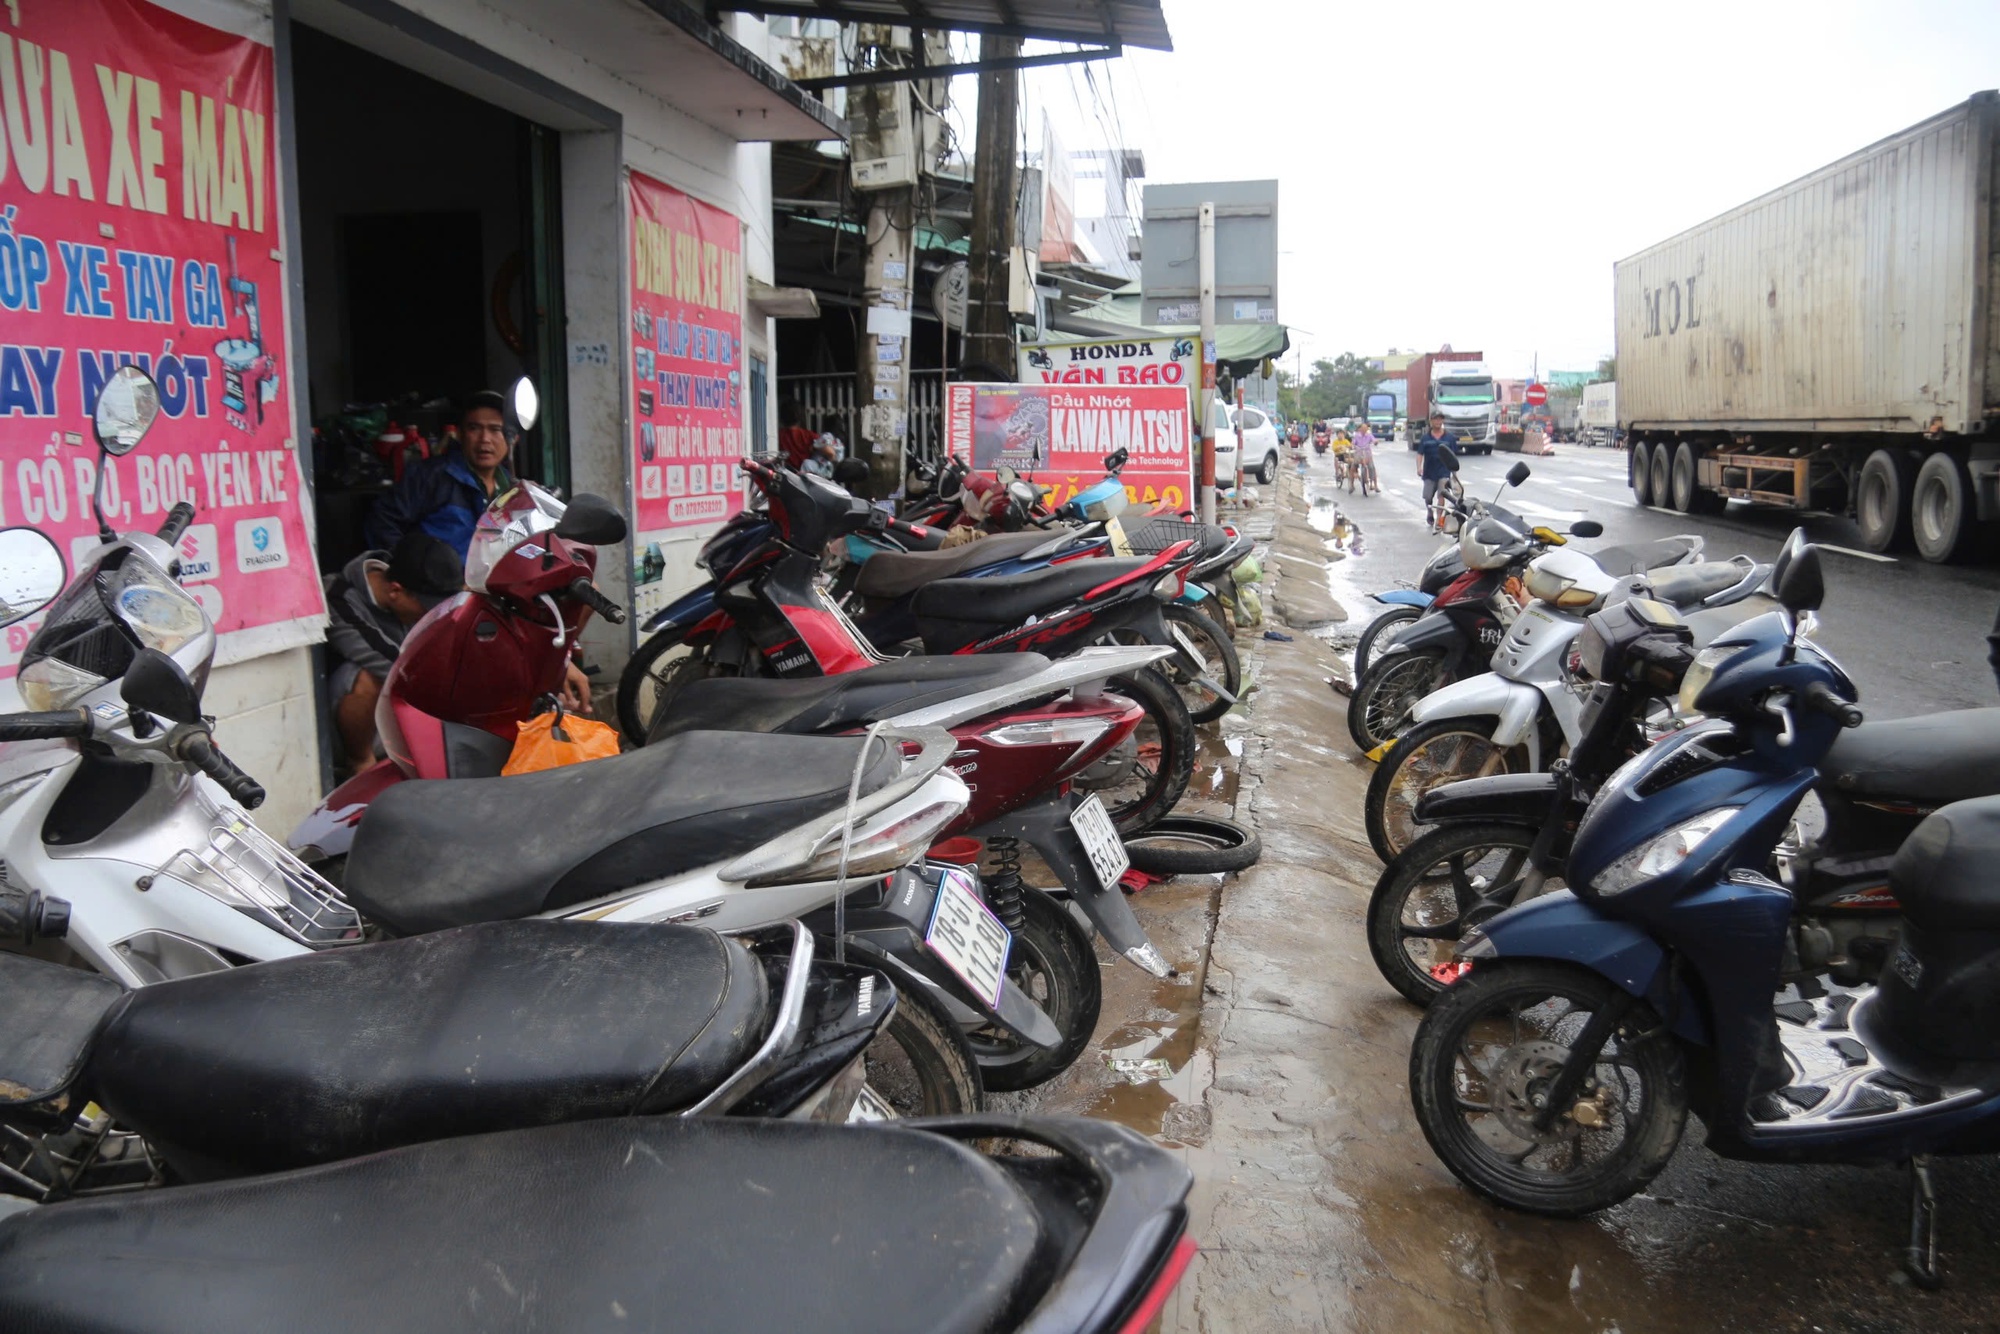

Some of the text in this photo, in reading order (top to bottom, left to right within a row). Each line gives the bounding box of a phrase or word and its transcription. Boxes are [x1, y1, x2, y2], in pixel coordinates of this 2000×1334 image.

[95, 63, 168, 215] XE
[180, 76, 265, 234] MÁY
[57, 240, 114, 318] XE
[116, 249, 175, 324] TAY
[183, 260, 227, 329] GA
[1643, 276, 1700, 339] MOL
[1070, 342, 1154, 361] HONDA
[77, 340, 209, 419] NỚT
[657, 370, 692, 409] THAY
[1051, 391, 1132, 408] Dầu Nhớt
[656, 425, 677, 458] THAY
[953, 386, 972, 467] AWAMATSU
[1051, 408, 1183, 453] KAWAMATSU
[17, 432, 68, 524] CỔ
[201, 440, 254, 509] YÊN
[256, 450, 288, 503] XE
[1139, 455, 1184, 467] Technology
[178, 560, 211, 577] UZUKI
[776, 653, 811, 672] YAMAHA
[904, 879, 916, 906] HONDA
[857, 975, 875, 1017] YAMAHA
